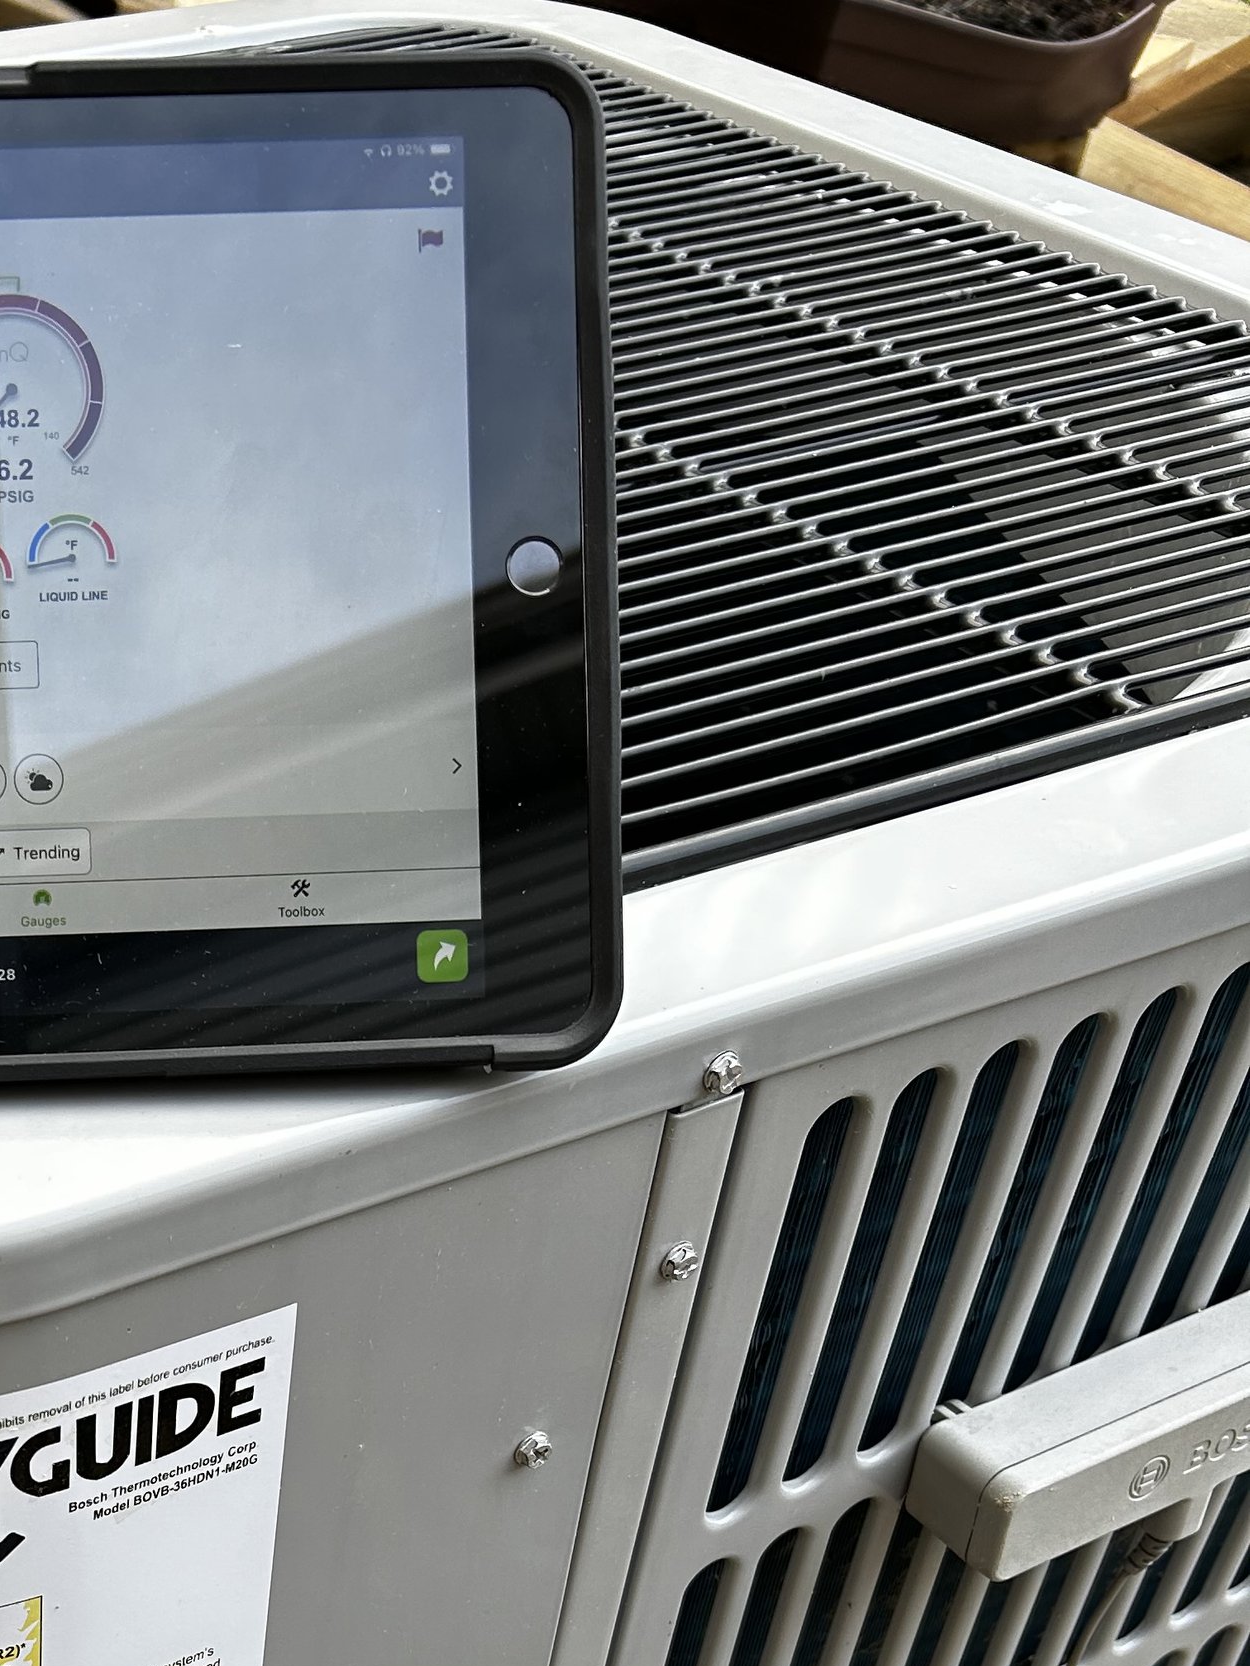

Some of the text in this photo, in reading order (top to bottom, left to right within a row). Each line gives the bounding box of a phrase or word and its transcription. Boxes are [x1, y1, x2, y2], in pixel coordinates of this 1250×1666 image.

[44, 431, 60, 441] 140
[70, 465, 90, 476] 542
[39, 590, 109, 603] LIQUID LINE
[13, 845, 81, 862] Trending
[277, 904, 326, 919] Toolbox
[20, 913, 67, 930] Gauges
[27, 1401, 72, 1422] removal
[74, 1396, 87, 1409] of
[87, 1390, 107, 1406] this
[109, 1379, 135, 1398] label
[137, 1369, 171, 1389] before
[173, 1352, 224, 1376] consumer
[225, 1334, 276, 1361] purchase.
[68, 1492, 108, 1514] Bosch
[111, 1452, 224, 1499] Thermotechnology
[93, 1454, 259, 1521] Model BOVB-36HDN1-M20G
